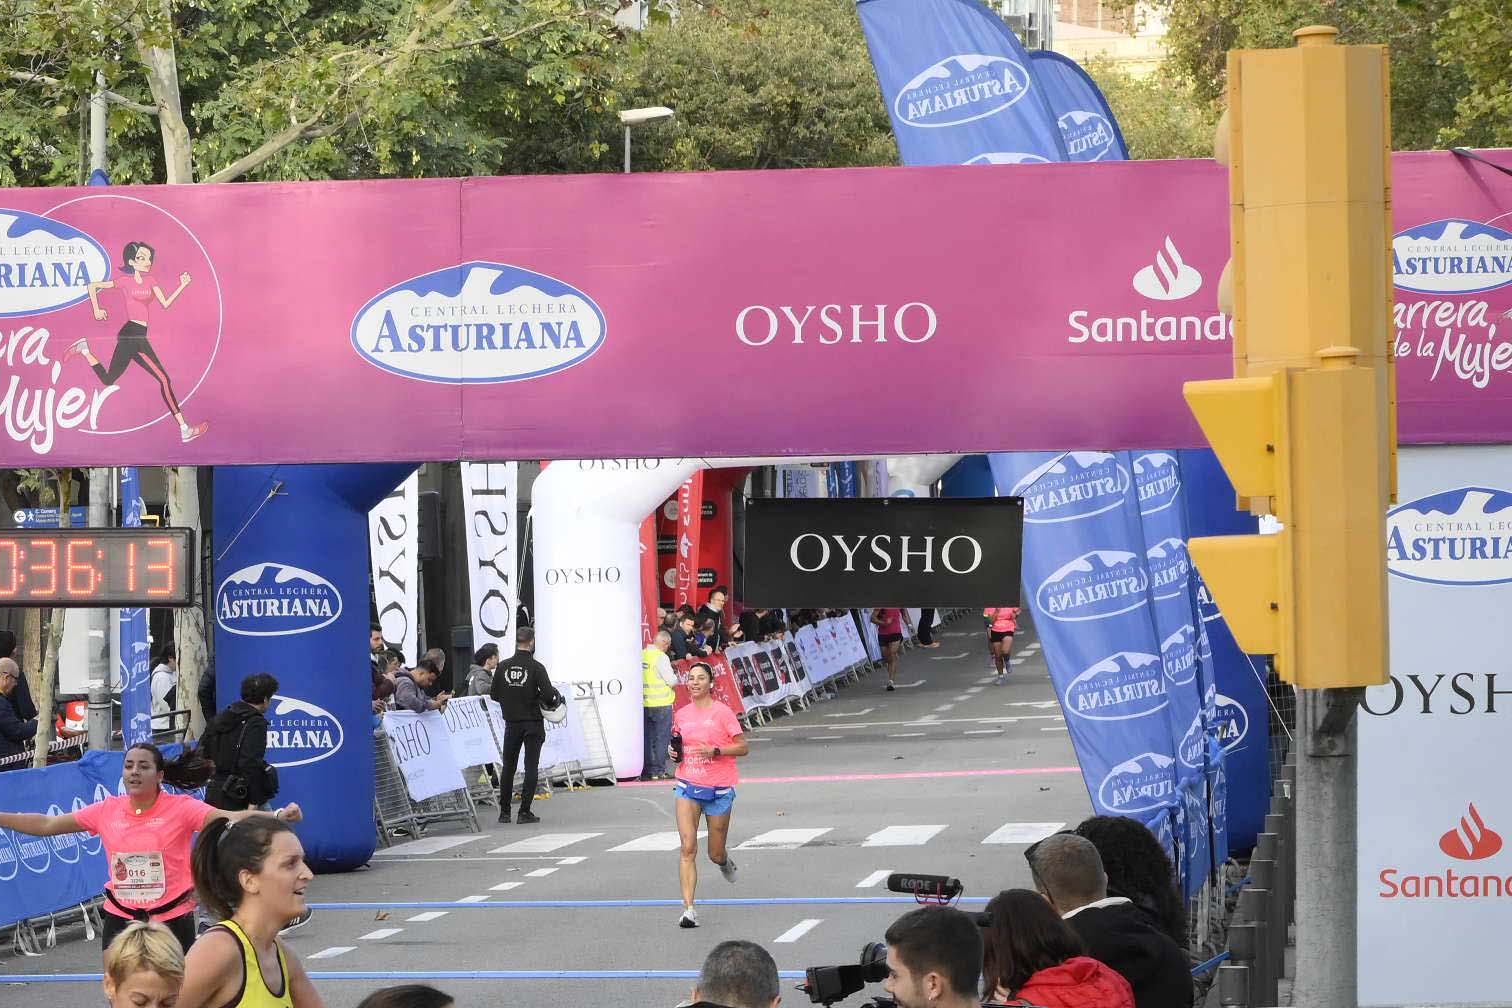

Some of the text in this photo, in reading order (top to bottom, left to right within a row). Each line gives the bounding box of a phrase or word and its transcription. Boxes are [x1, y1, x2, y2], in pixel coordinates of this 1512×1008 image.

[12, 246, 87, 256] LECHERA
[1407, 245, 1457, 253] CENTRAL
[410, 302, 578, 318] CENTRAL LECHERA
[1393, 300, 1489, 329] arrera
[370, 308, 586, 353] ASTURIANA
[735, 302, 938, 346] OYSHO
[1068, 309, 1234, 344] Santand
[1417, 328, 1435, 357] la
[1430, 324, 1512, 389] Muje
[1414, 522, 1481, 531] CENTRAL
[469, 462, 510, 638] OYSH
[790, 533, 982, 574] OYSHO
[545, 566, 621, 585] OYSHO
[233, 587, 328, 597] CENTRAL LECHERA
[220, 592, 333, 620] ASTURIANA
[511, 671, 522, 680] BP
[279, 719, 329, 727] LECHERA
[267, 730, 333, 749] RIANA
